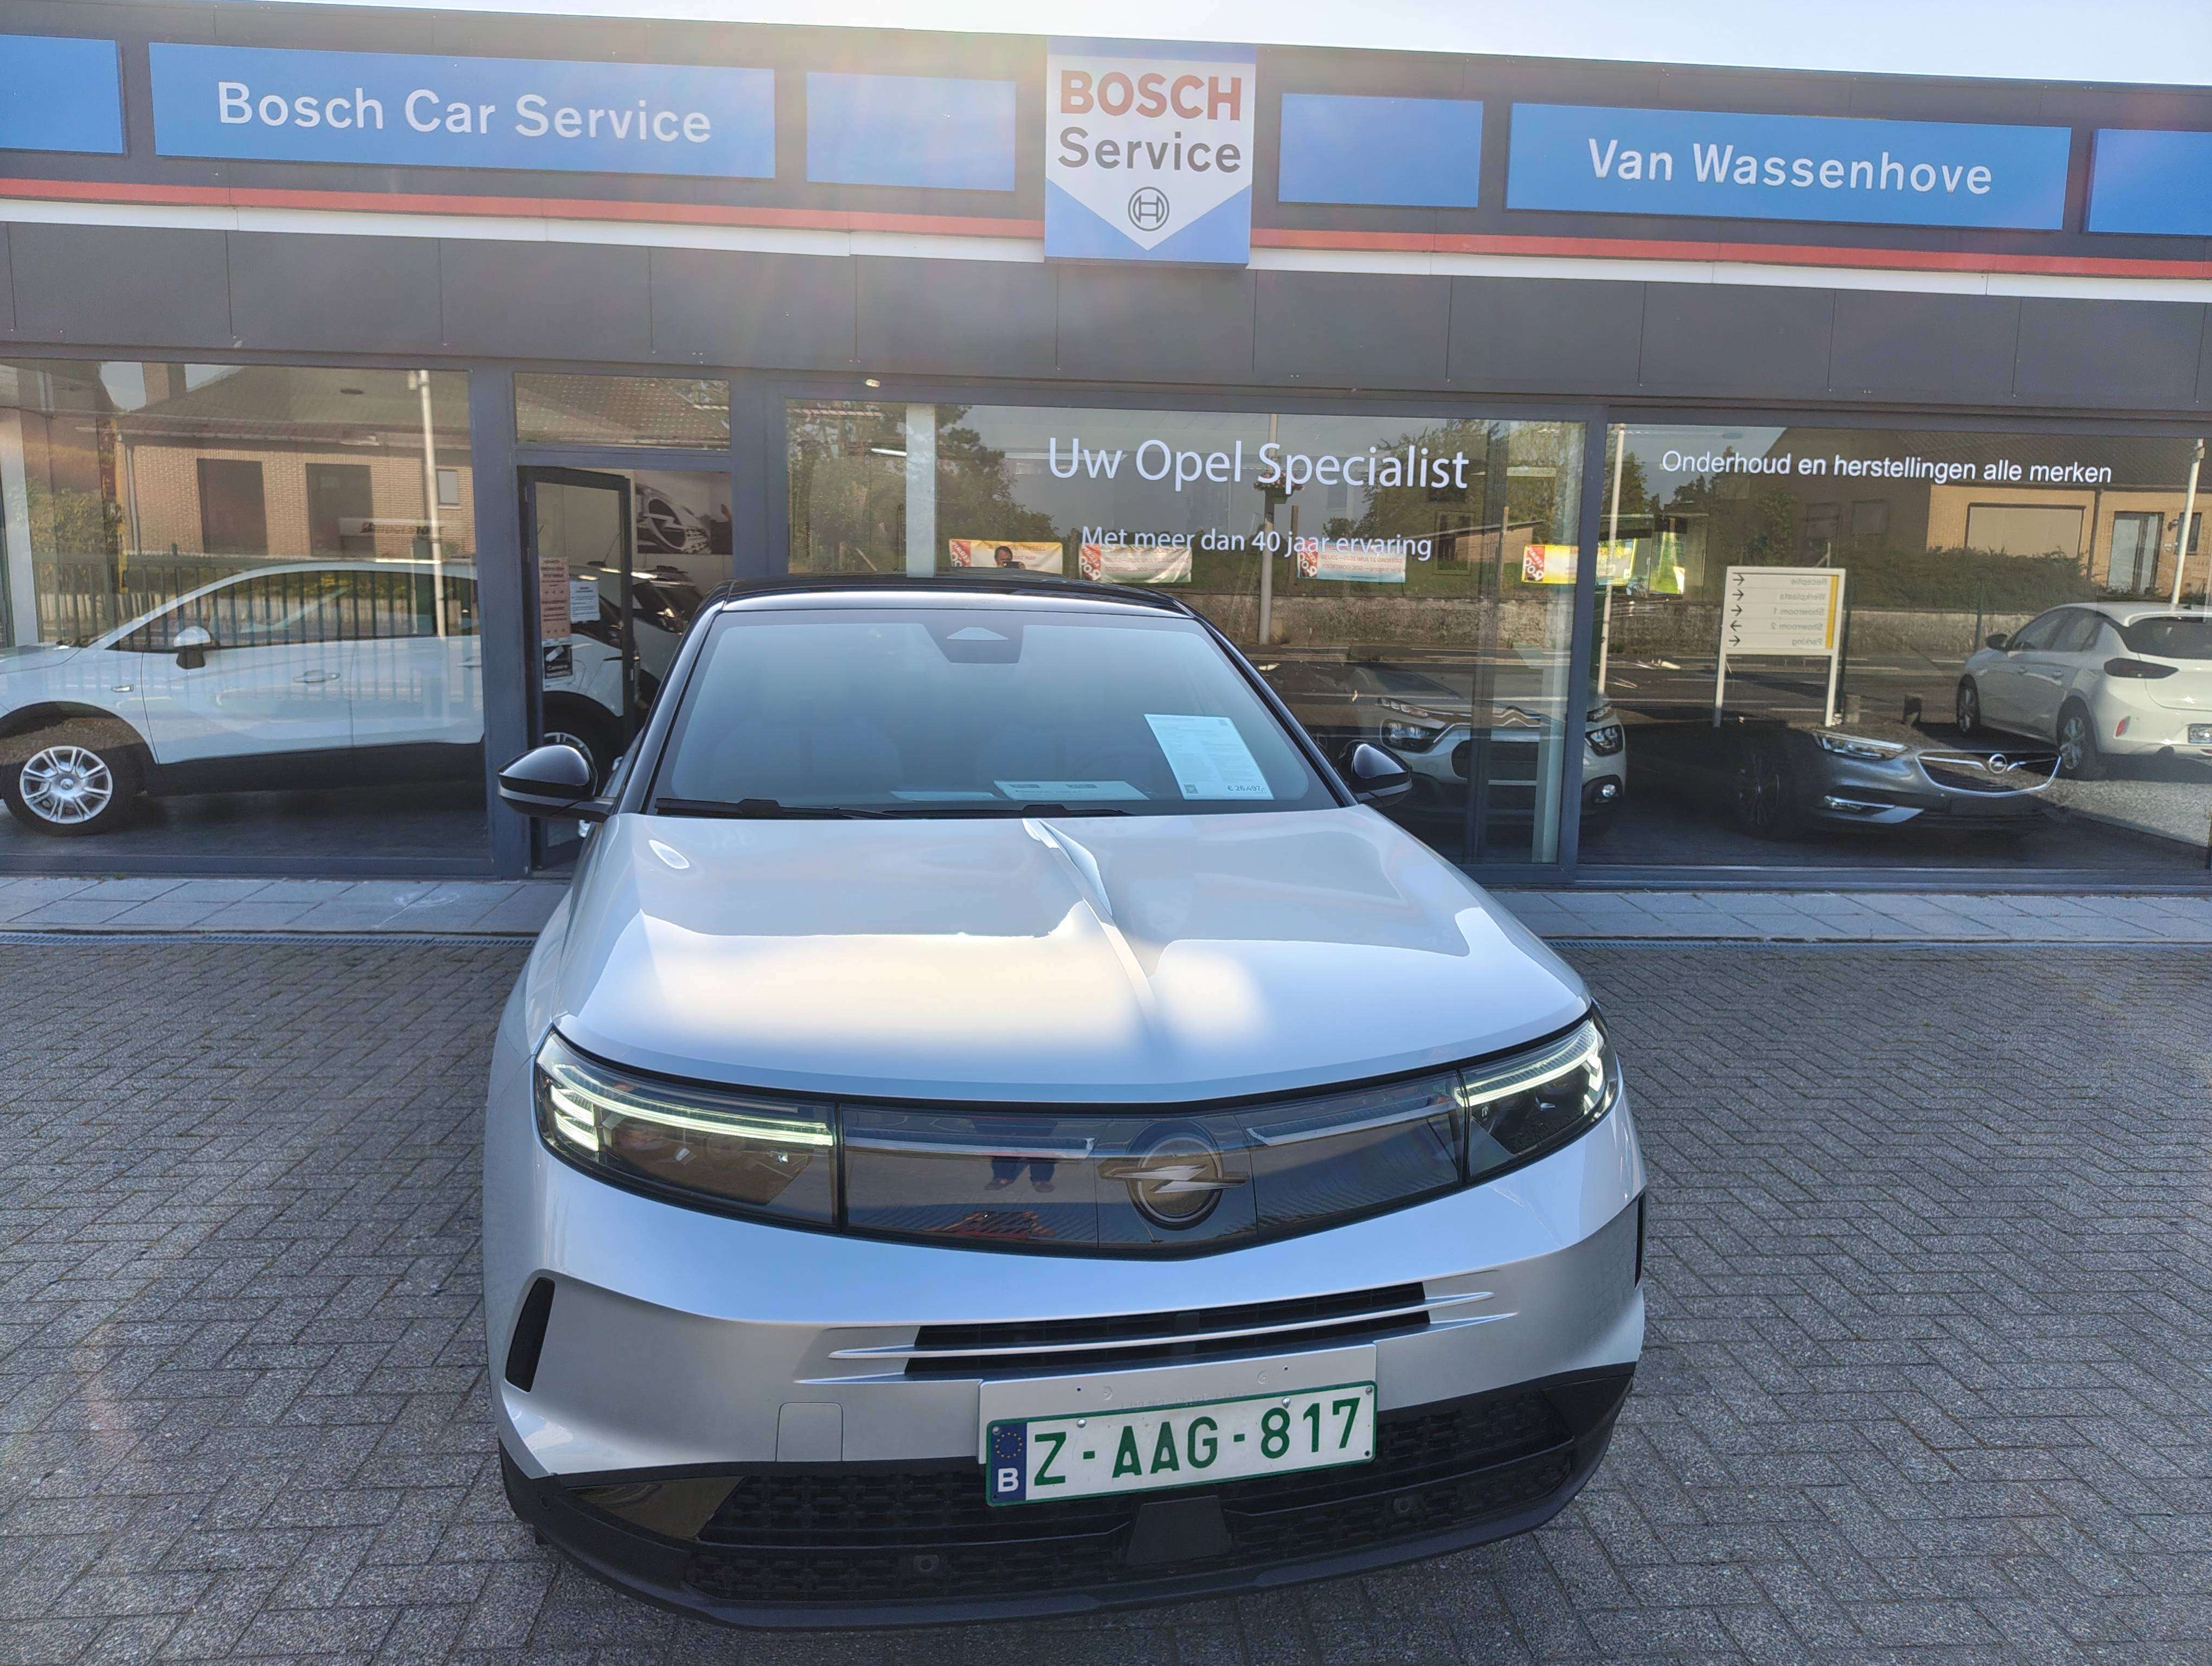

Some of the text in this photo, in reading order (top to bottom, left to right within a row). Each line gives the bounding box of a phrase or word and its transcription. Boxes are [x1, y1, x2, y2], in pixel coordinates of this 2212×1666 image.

[218, 81, 711, 143] Bosch Car Service
[1060, 70, 1242, 120] BOSCH
[1058, 127, 1241, 173] Service
[1588, 138, 1992, 194] Van Wassenhove
[1050, 438, 1469, 495] Uw Opel Specialist
[1662, 451, 2111, 484] Onderhoud en herstellingen alle merken
[1082, 526, 1431, 561] Met meer dan 40 jaar ervaring
[997, 1396, 1361, 1492] B Z-AAG-817
